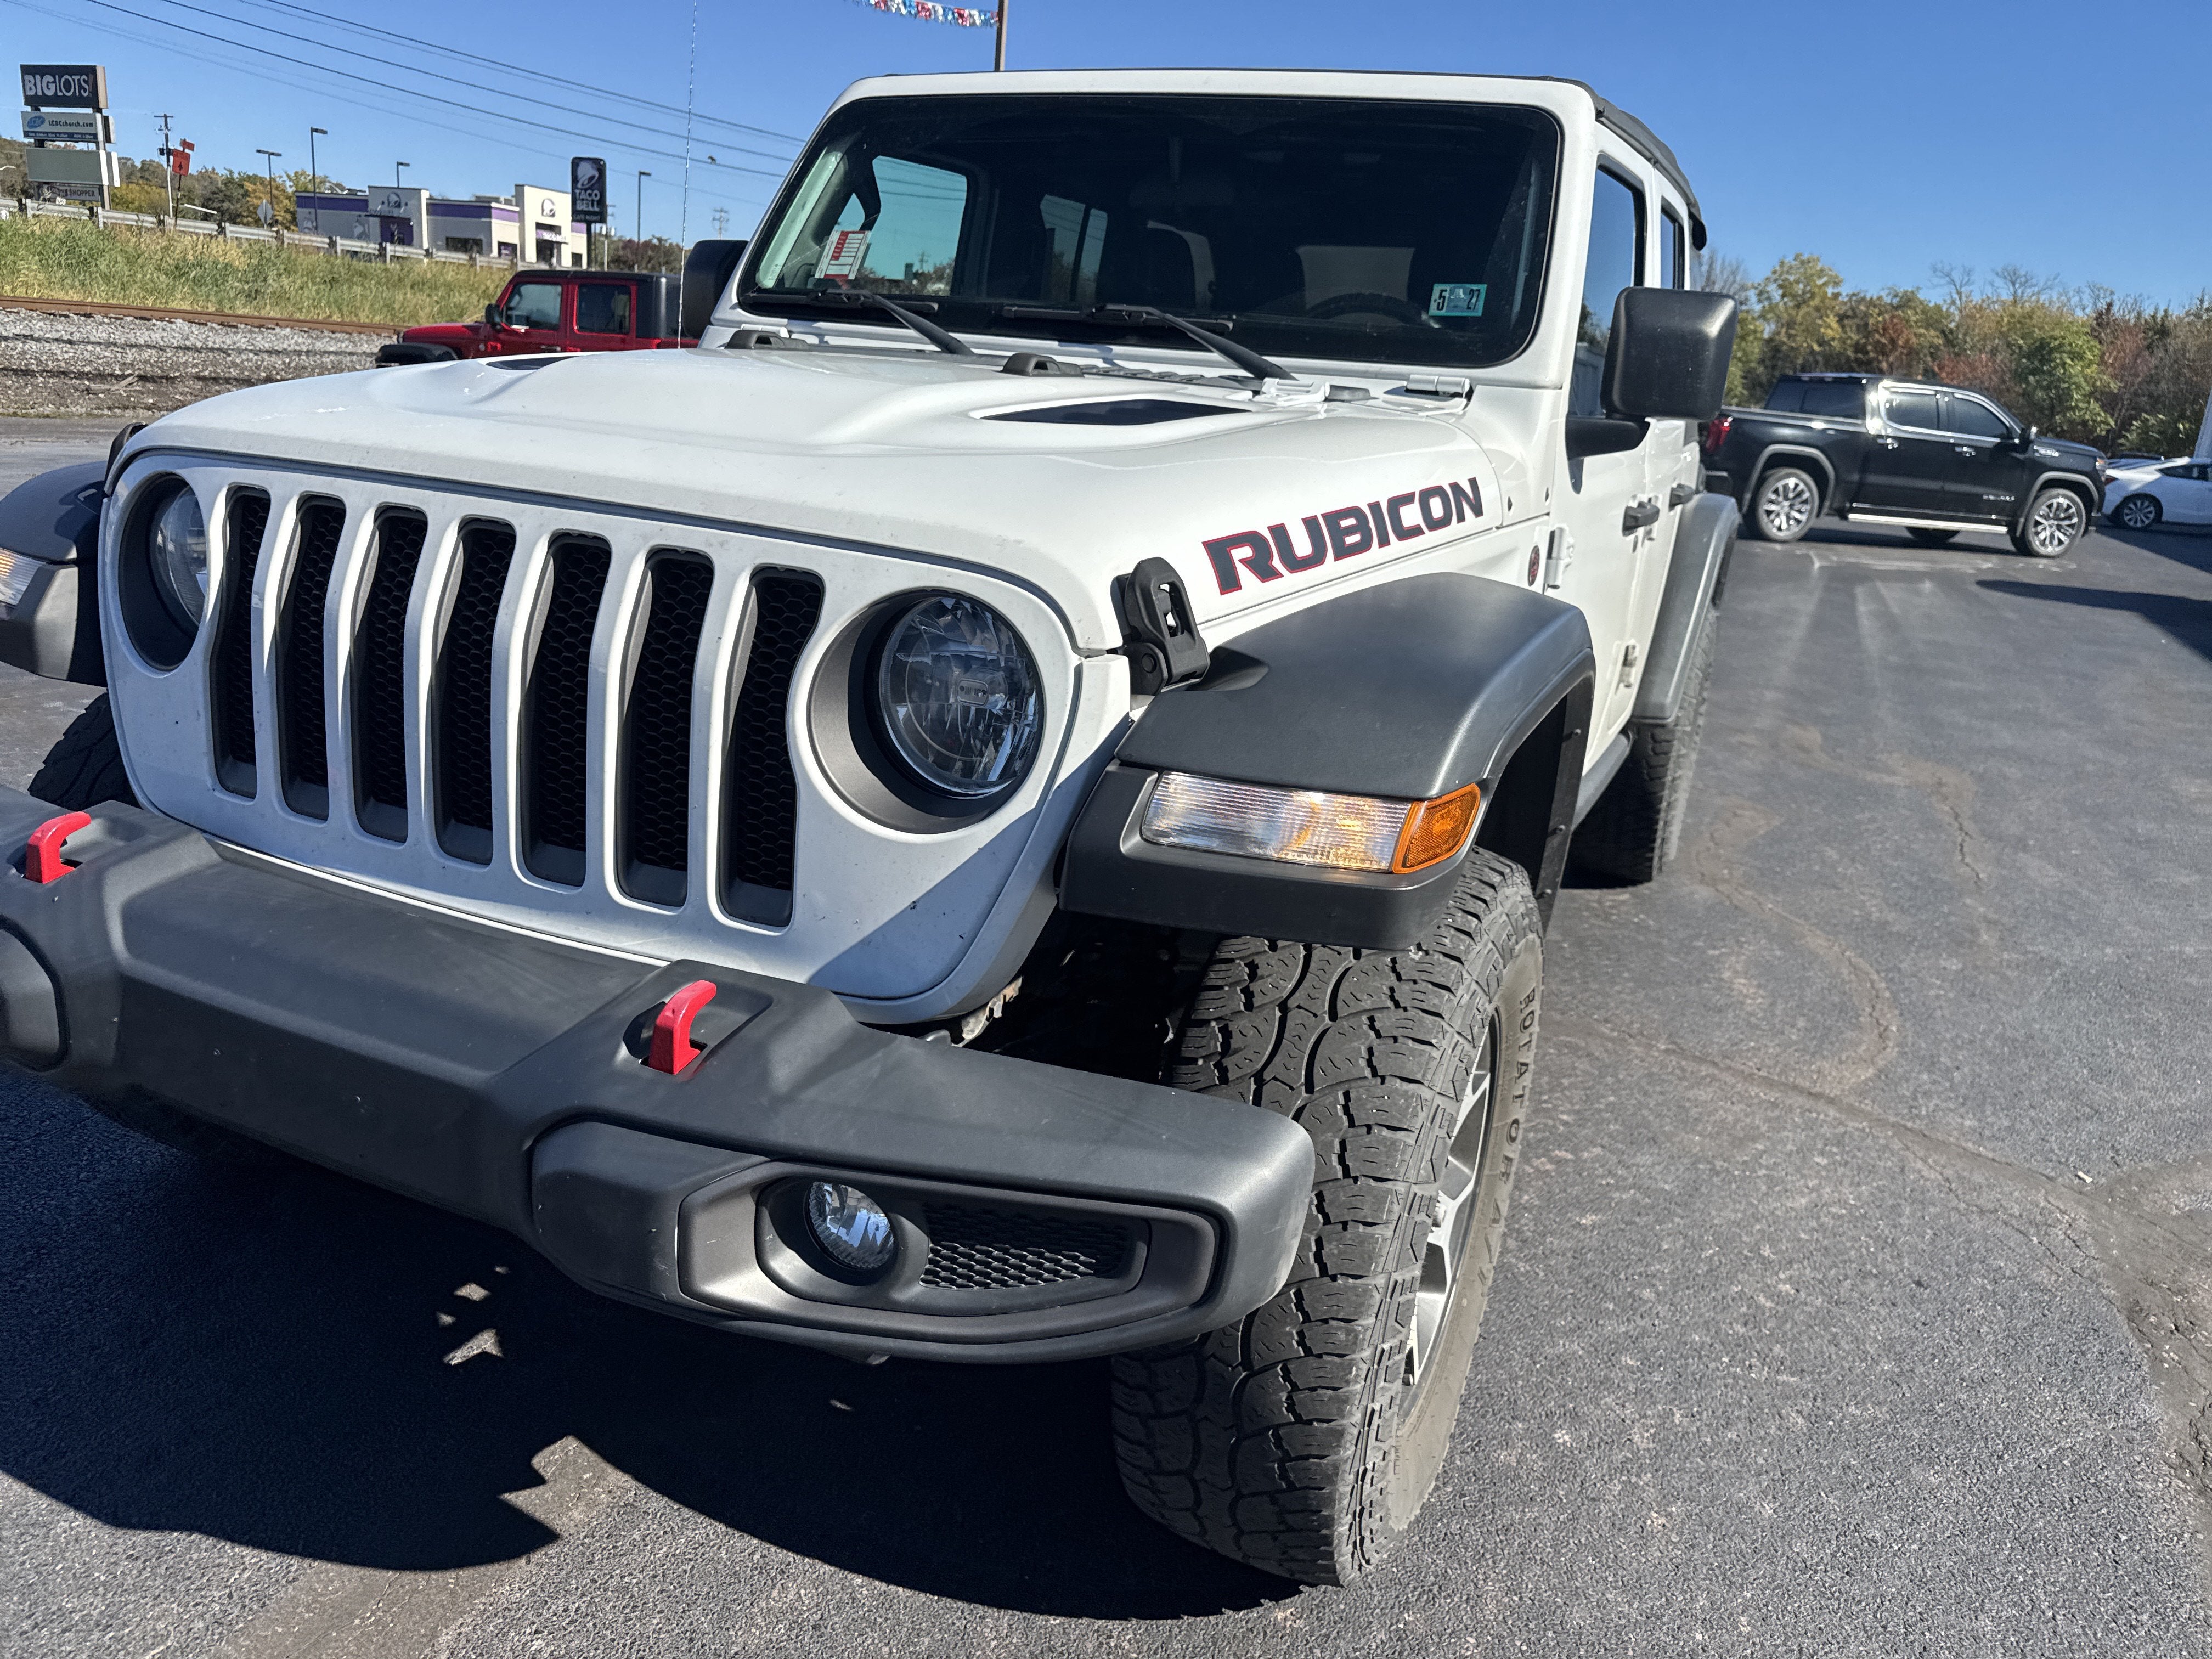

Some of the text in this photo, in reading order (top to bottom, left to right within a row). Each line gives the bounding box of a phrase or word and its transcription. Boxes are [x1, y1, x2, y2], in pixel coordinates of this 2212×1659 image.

[574, 189, 600, 201] TACO
[575, 200, 600, 211] BELL
[1436, 288, 1481, 311] 5 27
[1201, 476, 1484, 596] RUBICON
[1499, 987, 1536, 1185] ROTATOR
